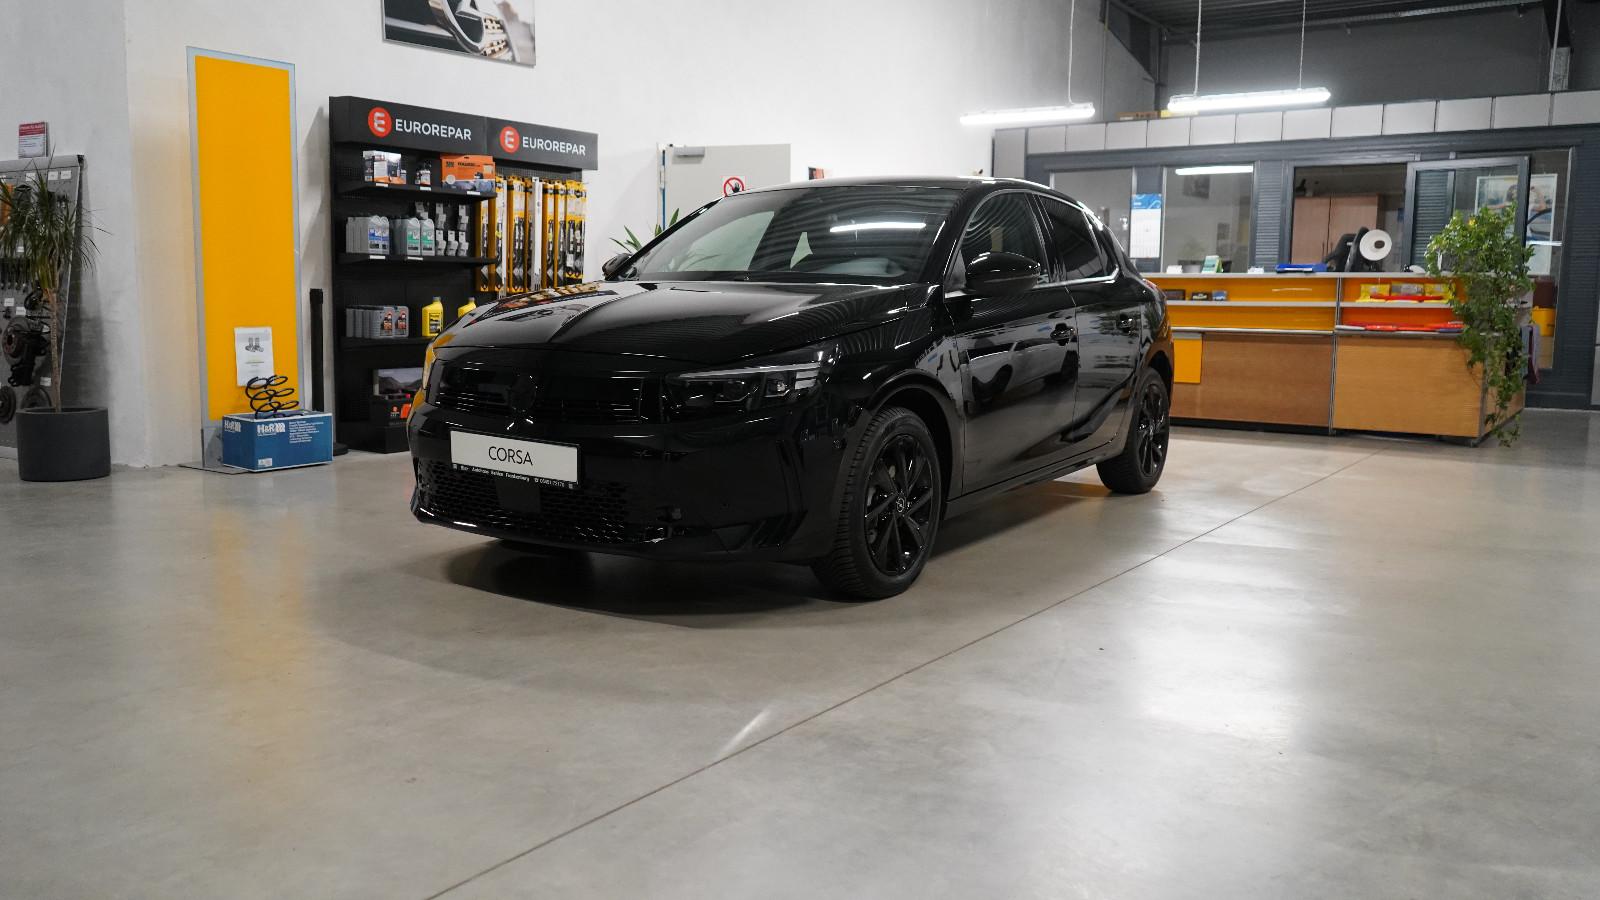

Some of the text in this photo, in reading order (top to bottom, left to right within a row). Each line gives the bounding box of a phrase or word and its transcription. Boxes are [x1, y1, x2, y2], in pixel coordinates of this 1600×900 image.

[395, 118, 472, 141] EUROREPAR
[522, 136, 586, 157] EUROREPAR
[488, 446, 533, 466] CORSA
